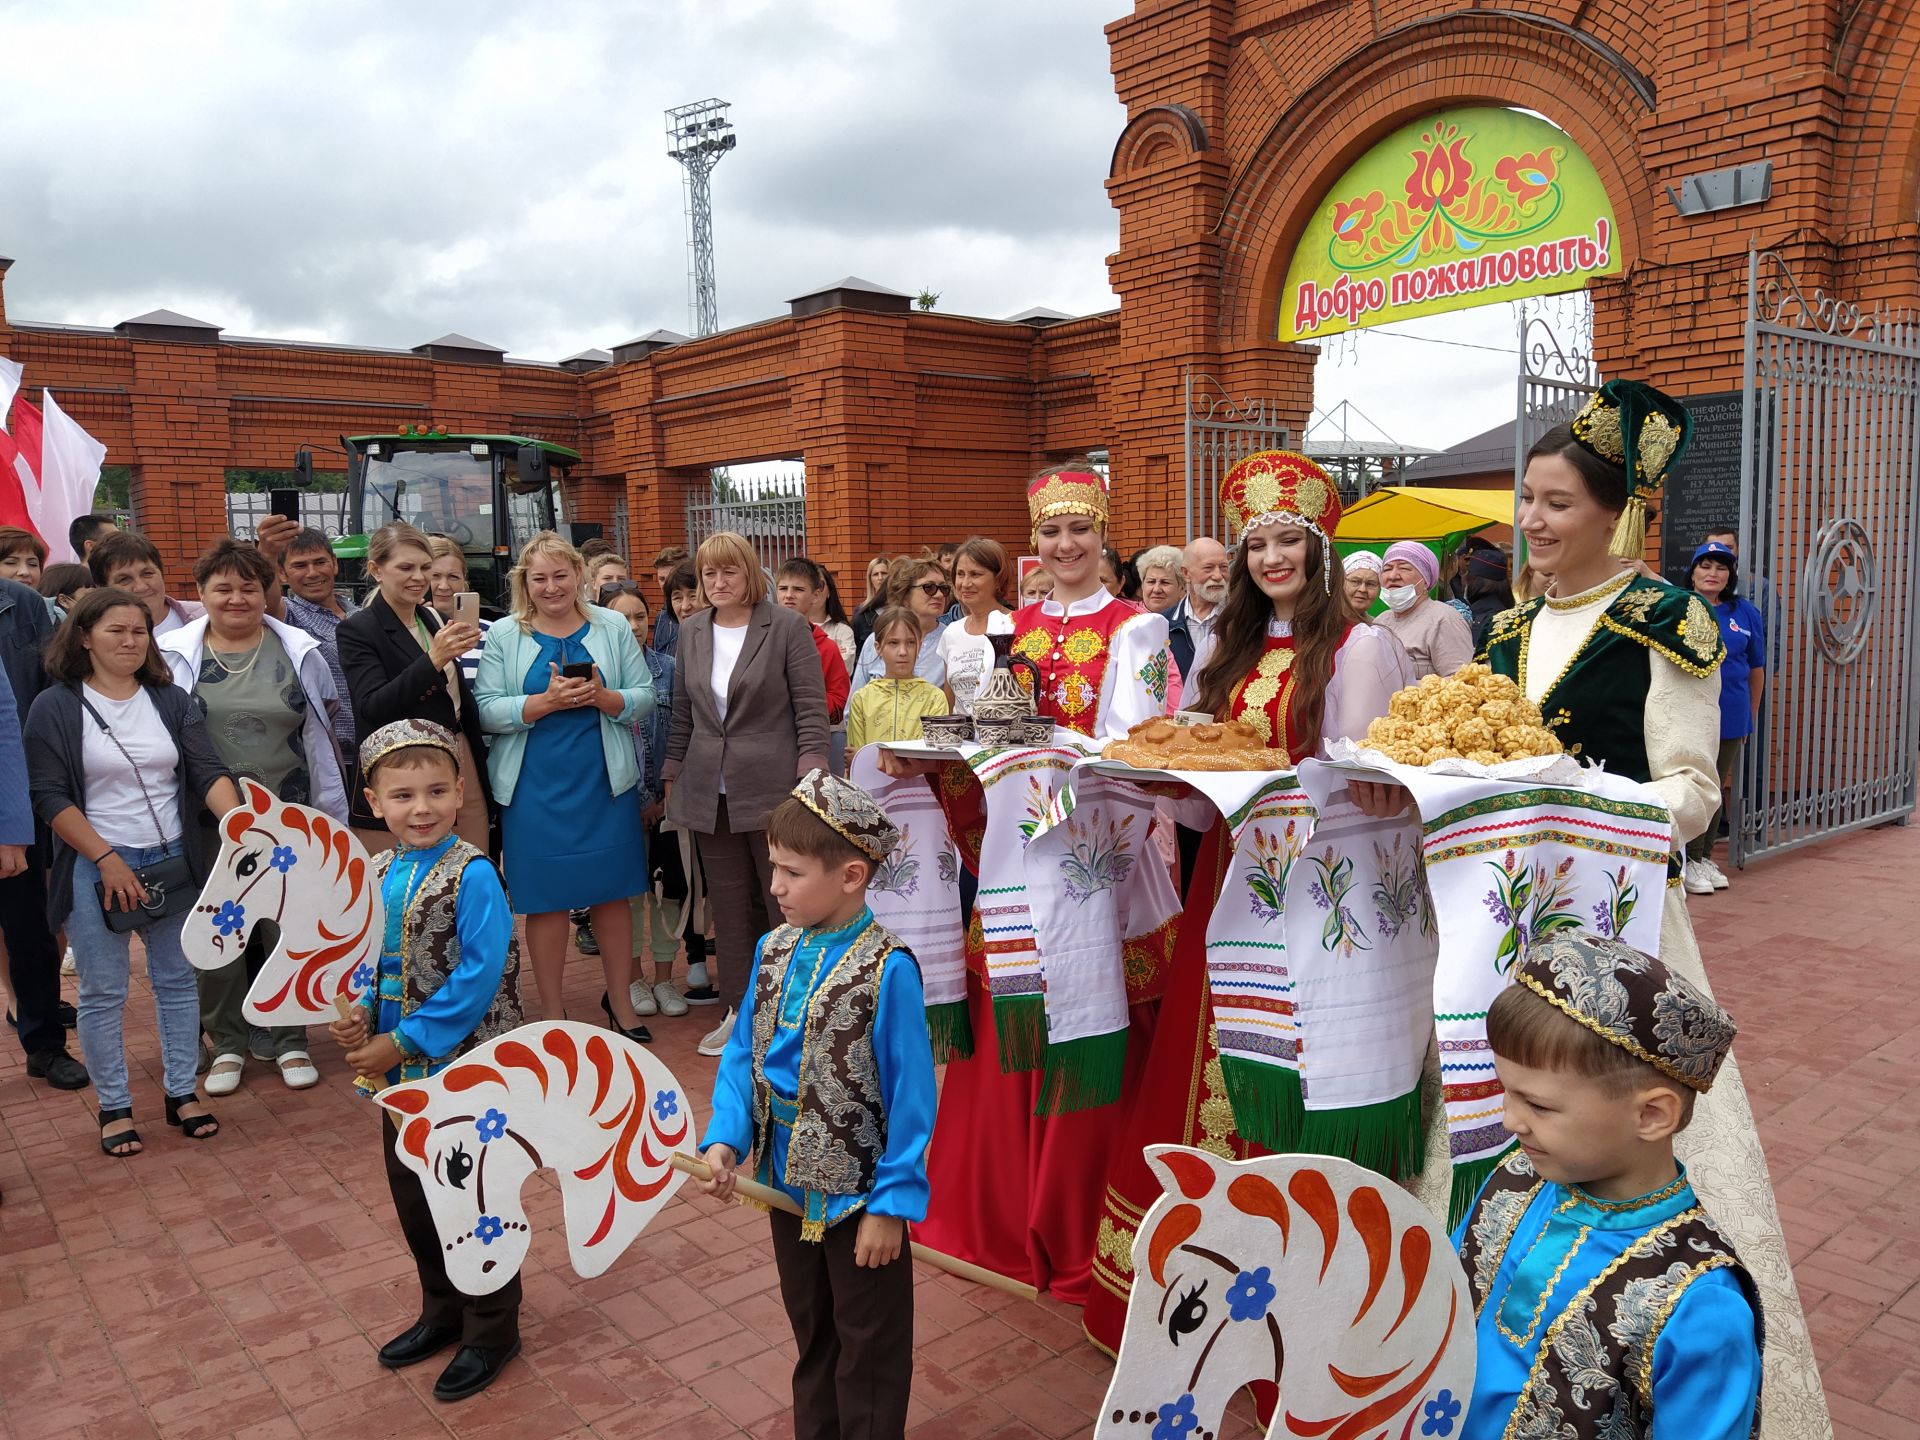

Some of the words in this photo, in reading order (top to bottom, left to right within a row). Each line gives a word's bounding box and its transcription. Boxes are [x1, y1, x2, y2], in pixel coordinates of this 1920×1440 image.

[1294, 274, 1385, 332] Добро
[1392, 217, 1610, 304] пожаловать!
[1712, 423, 1743, 432] РЕСПУБ
[1699, 440, 1743, 450] МИННЕХА
